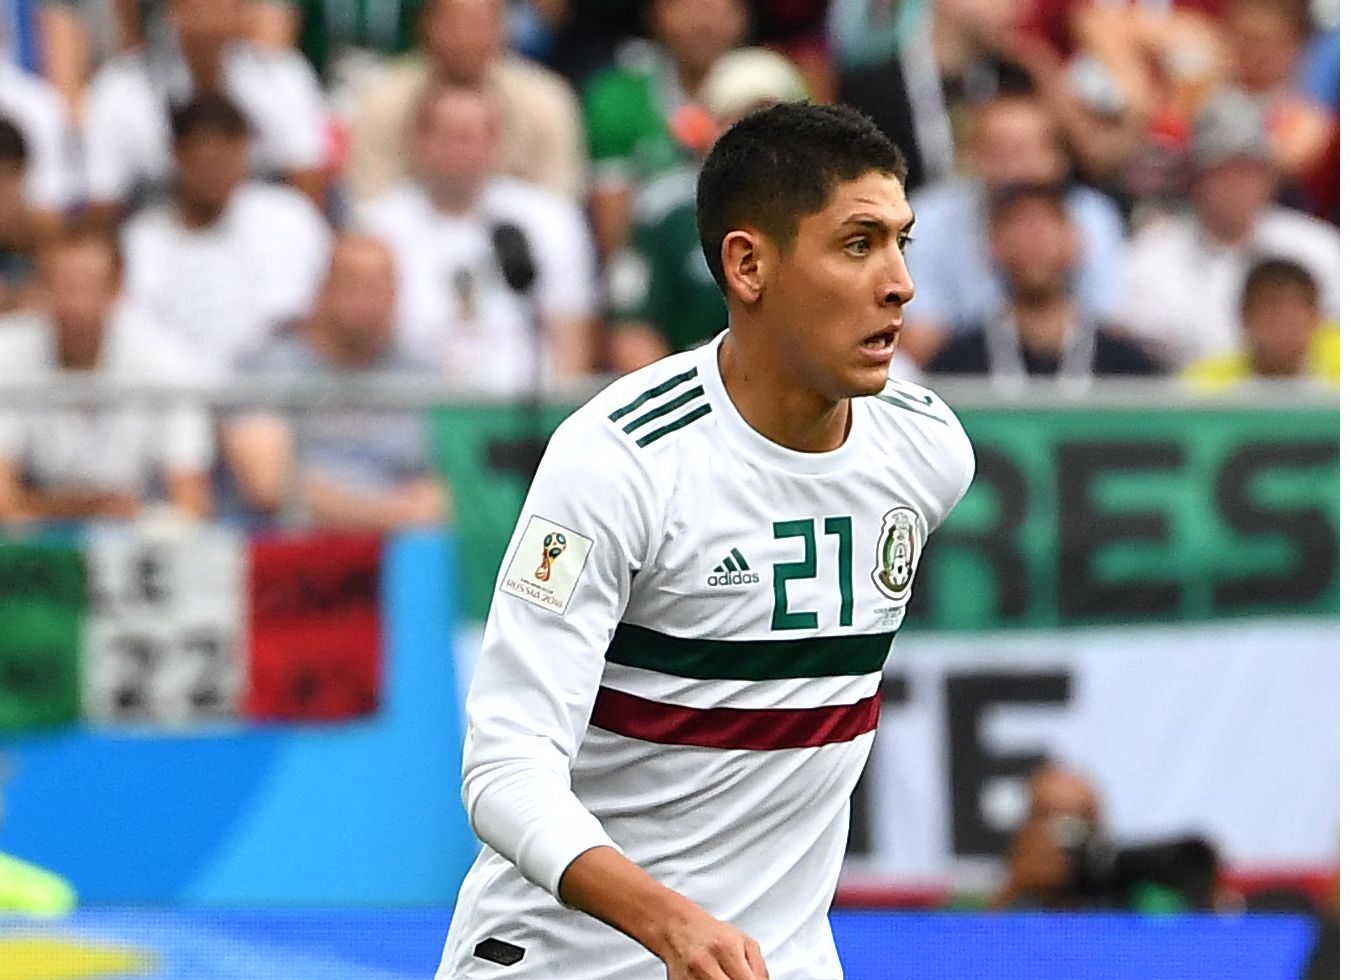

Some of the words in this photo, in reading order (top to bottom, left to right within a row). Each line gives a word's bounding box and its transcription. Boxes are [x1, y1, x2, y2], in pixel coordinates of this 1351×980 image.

[706, 569, 760, 587] adidas
[771, 514, 853, 631] 21
[505, 578, 541, 599] RUSSIA
